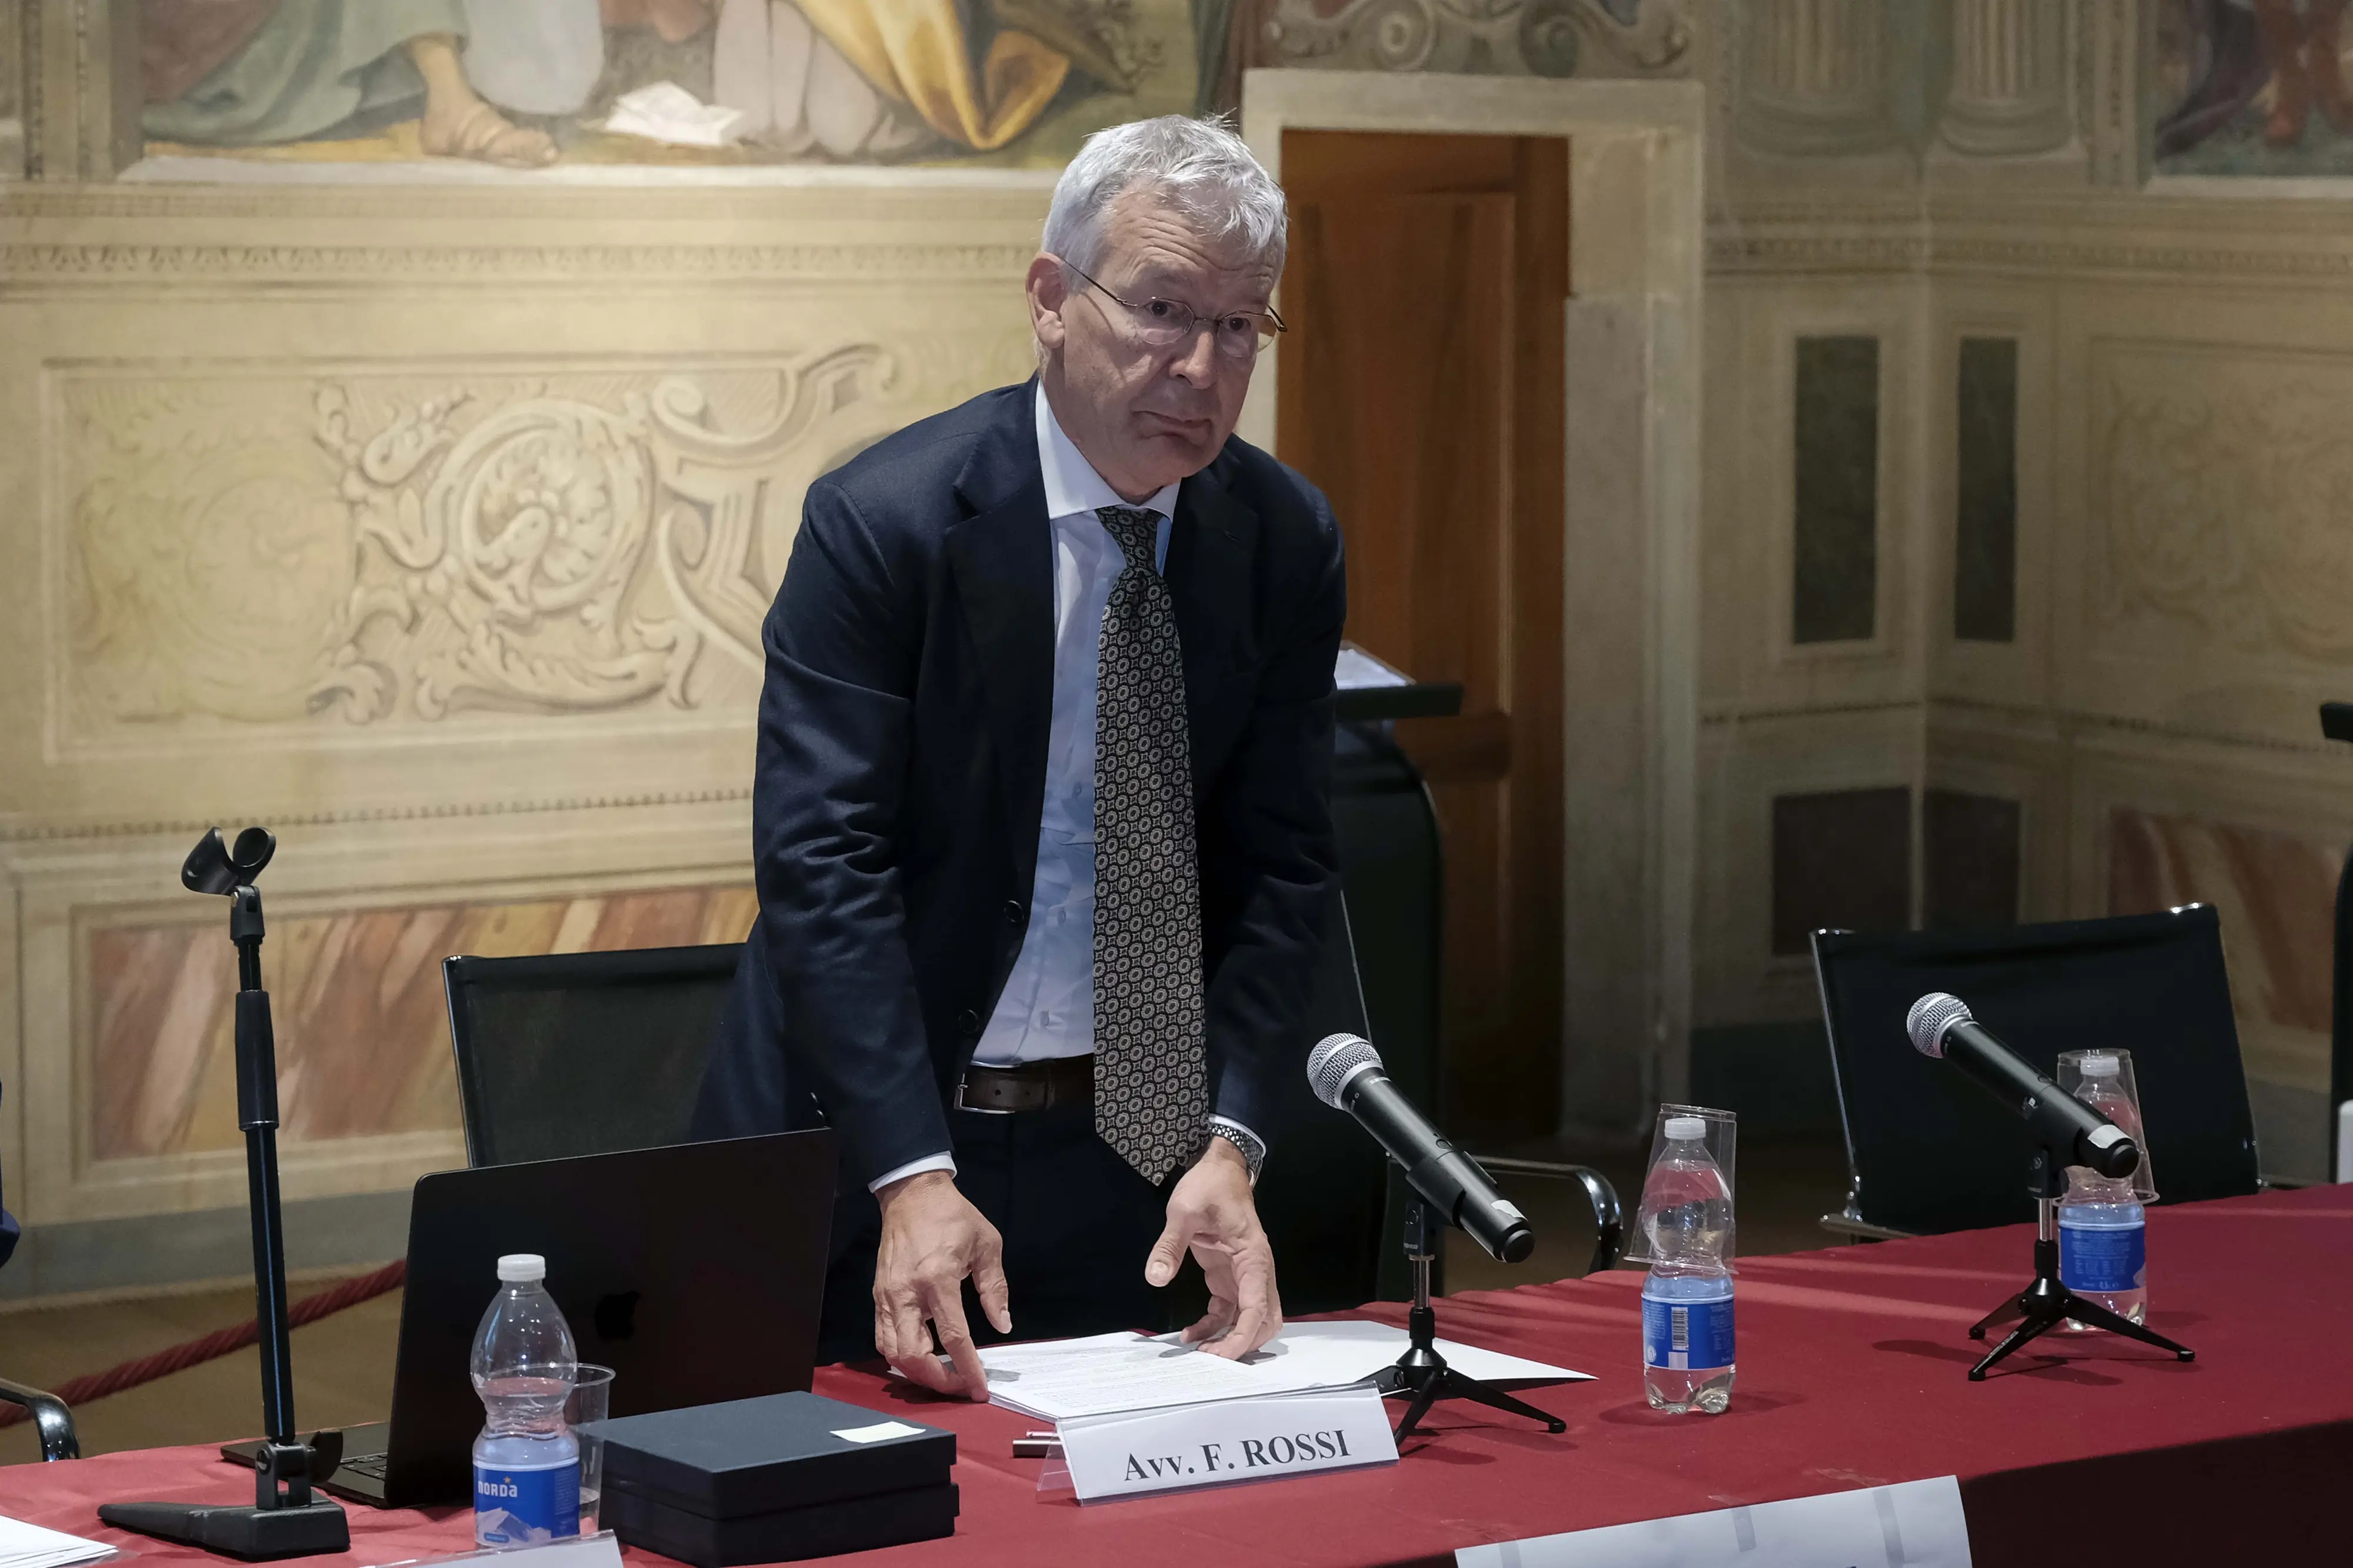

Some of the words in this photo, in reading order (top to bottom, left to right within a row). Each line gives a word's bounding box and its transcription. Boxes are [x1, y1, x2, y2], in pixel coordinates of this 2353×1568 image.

[1124, 1453, 1195, 1482] Avv.
[1199, 1443, 1235, 1472] F.
[1239, 1429, 1352, 1467] ROSSI
